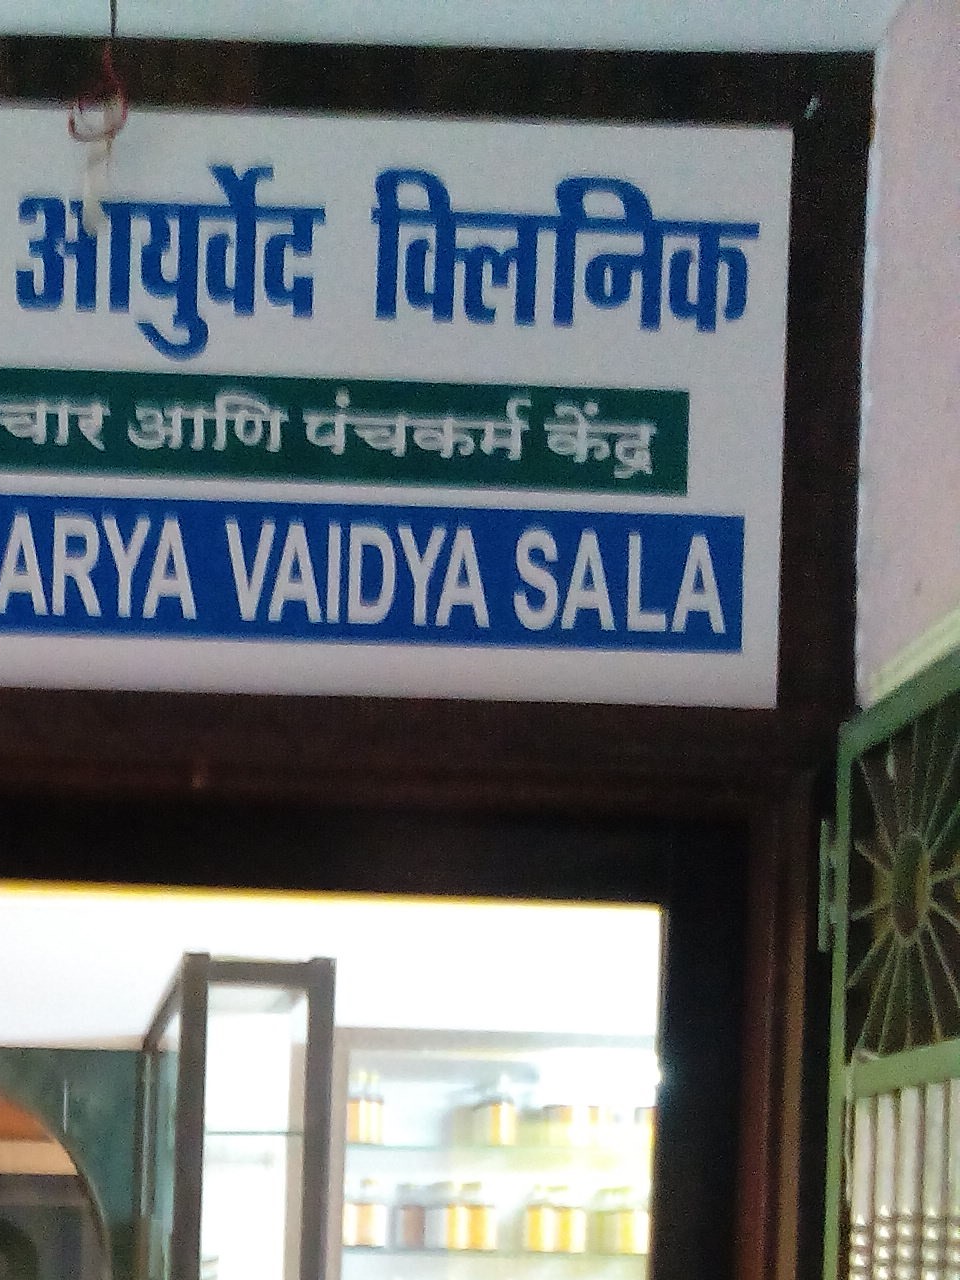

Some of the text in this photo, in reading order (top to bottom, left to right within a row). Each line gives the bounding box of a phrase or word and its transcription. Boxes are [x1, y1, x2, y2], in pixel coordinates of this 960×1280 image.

[15, 164, 327, 360] आयुर्वेद
[370, 168, 761, 335] क्लिनिक
[127, 390, 289, 454] आणि
[304, 387, 530, 462] पंचकर्म
[543, 399, 658, 479] केंद्र
[226, 520, 490, 630] VAIDYA
[512, 528, 727, 635] SALA
